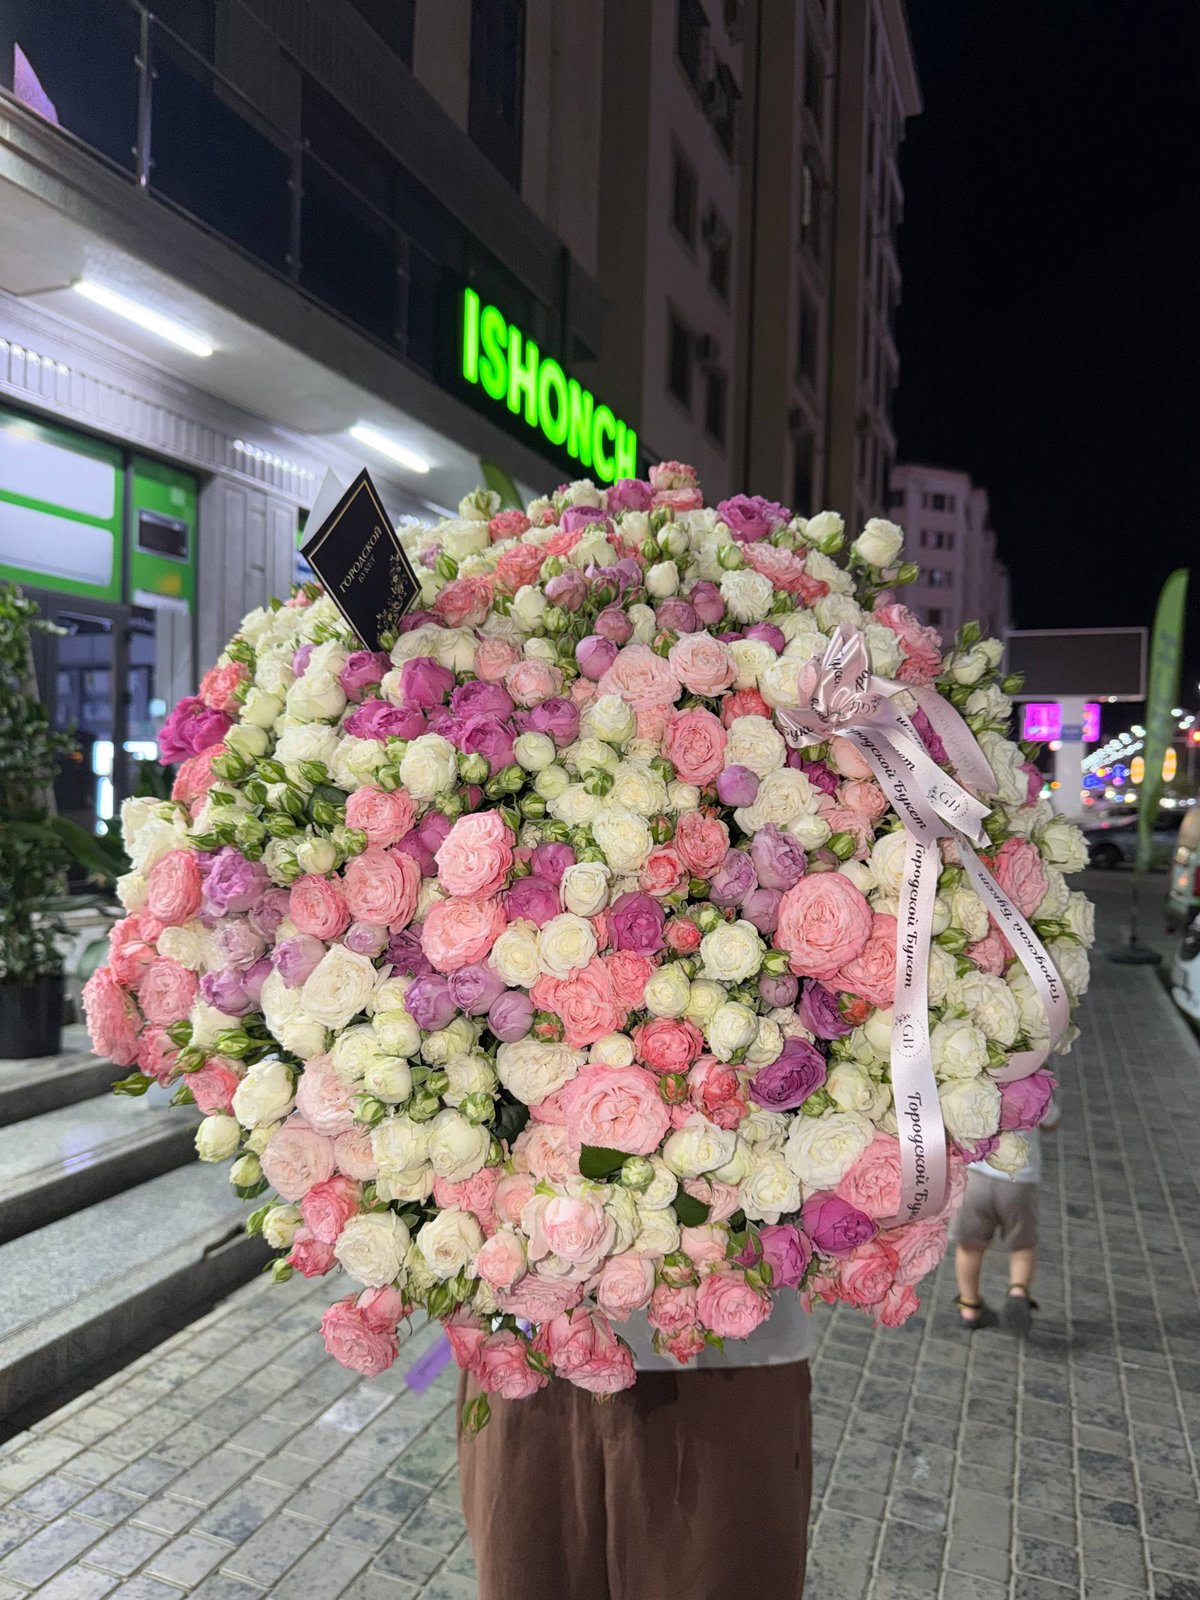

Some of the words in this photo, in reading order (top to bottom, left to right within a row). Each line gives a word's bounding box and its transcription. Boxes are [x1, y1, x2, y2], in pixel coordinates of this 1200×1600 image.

[463, 287, 637, 486] ISHONCH
[847, 728, 895, 780] родской
[893, 780, 927, 830] Букет
[939, 791, 961, 812] GB
[977, 871, 1014, 921] Букет
[902, 930, 918, 989] Букет
[1012, 920, 1061, 1003] Городской
[902, 1024, 914, 1049] GB
[904, 1091, 929, 1187] Городской
